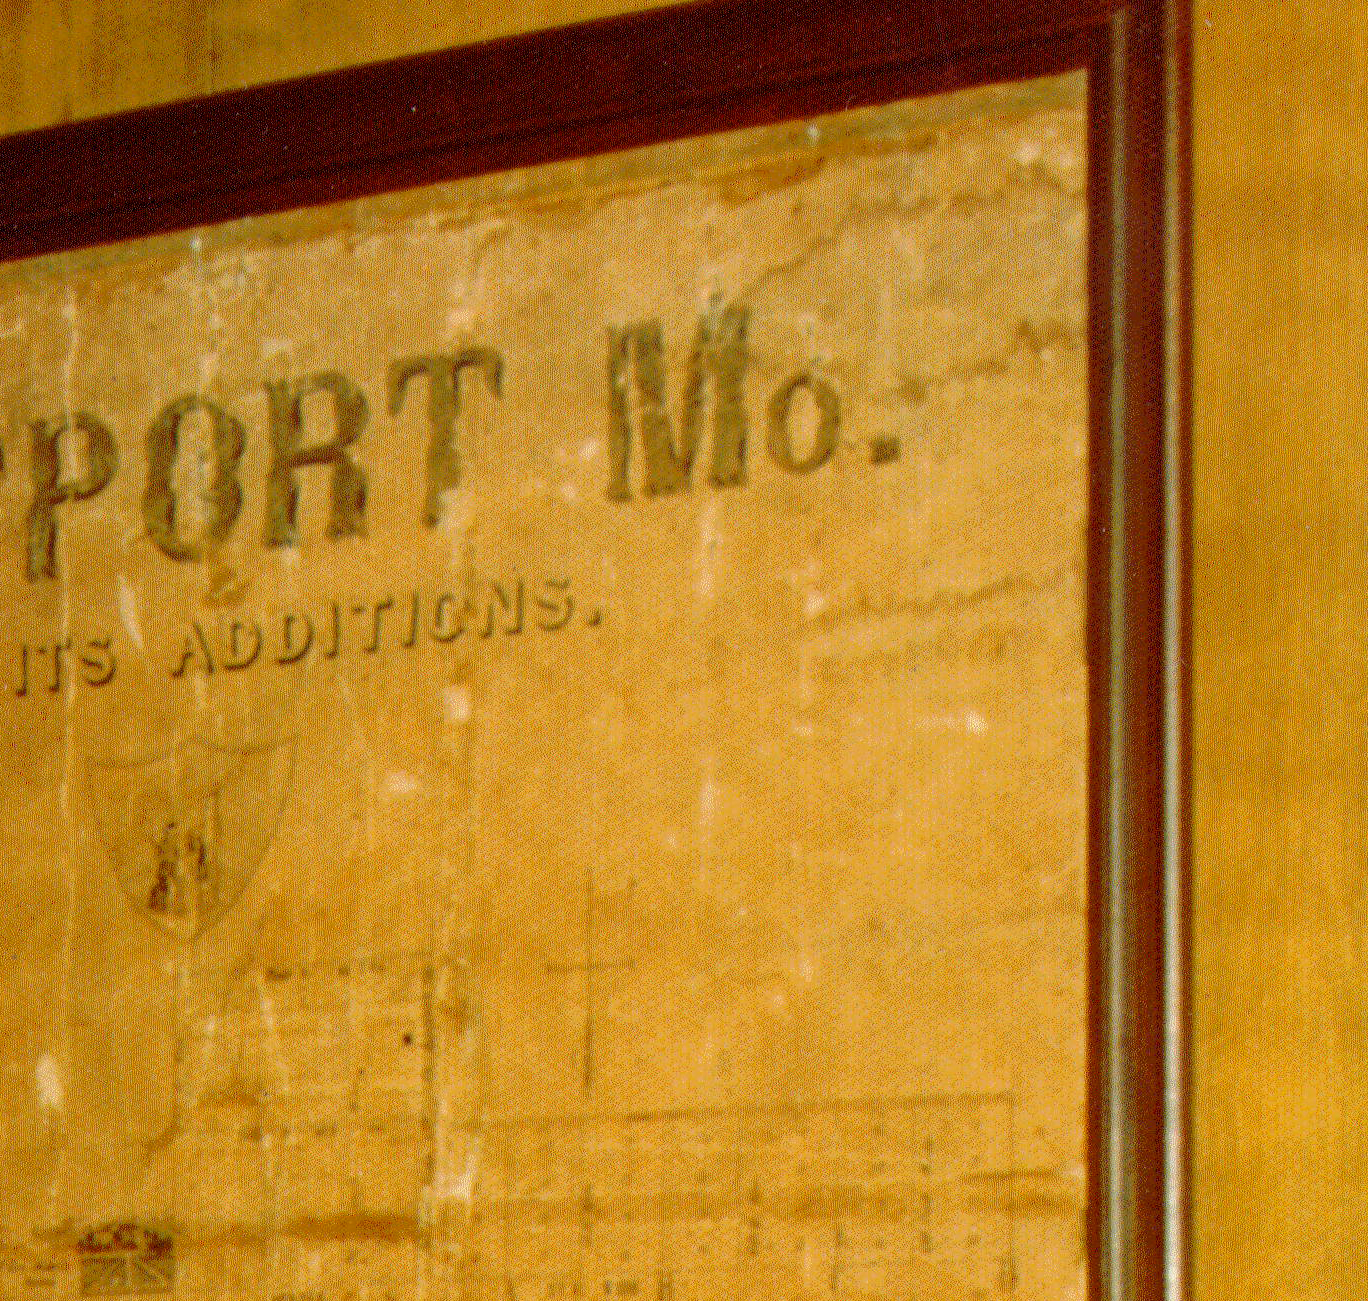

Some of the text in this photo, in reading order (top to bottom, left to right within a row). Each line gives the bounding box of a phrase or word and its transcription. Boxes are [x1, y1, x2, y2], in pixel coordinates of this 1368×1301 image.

[605, 300, 903, 503] Mo.
[16, 636, 119, 698] ITS
[170, 577, 604, 680] ADDITIONS.
